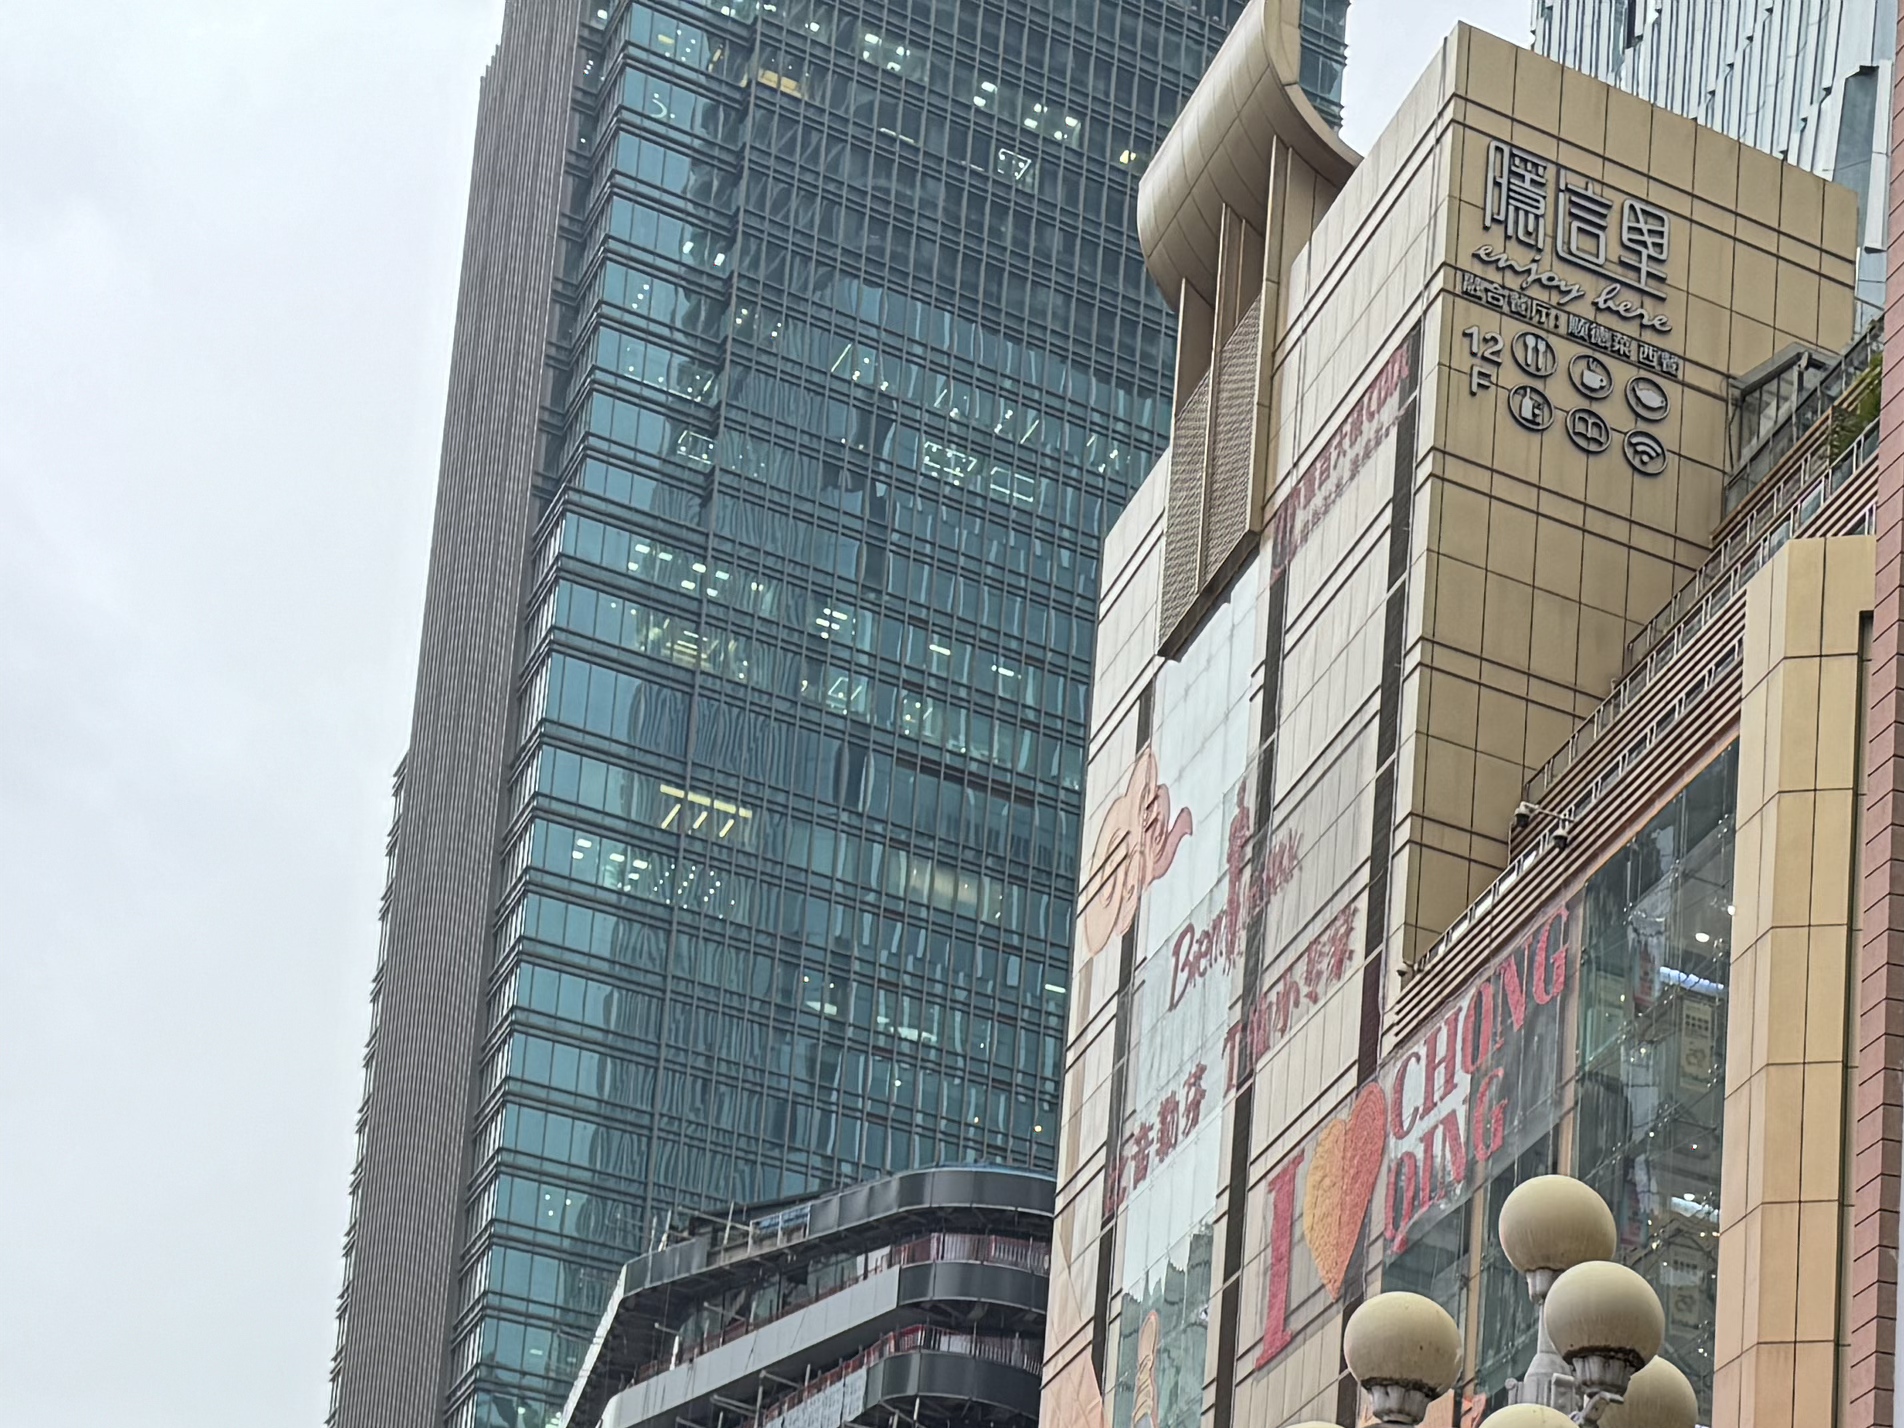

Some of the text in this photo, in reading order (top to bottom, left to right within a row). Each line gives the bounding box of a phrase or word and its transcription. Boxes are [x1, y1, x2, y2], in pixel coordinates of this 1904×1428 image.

[1473, 243, 1674, 332] enjoy here
[1464, 325, 1505, 362] 12
[1470, 364, 1493, 395] F
[1254, 901, 1573, 1370] I CHONG
[1383, 1068, 1509, 1254] QING
